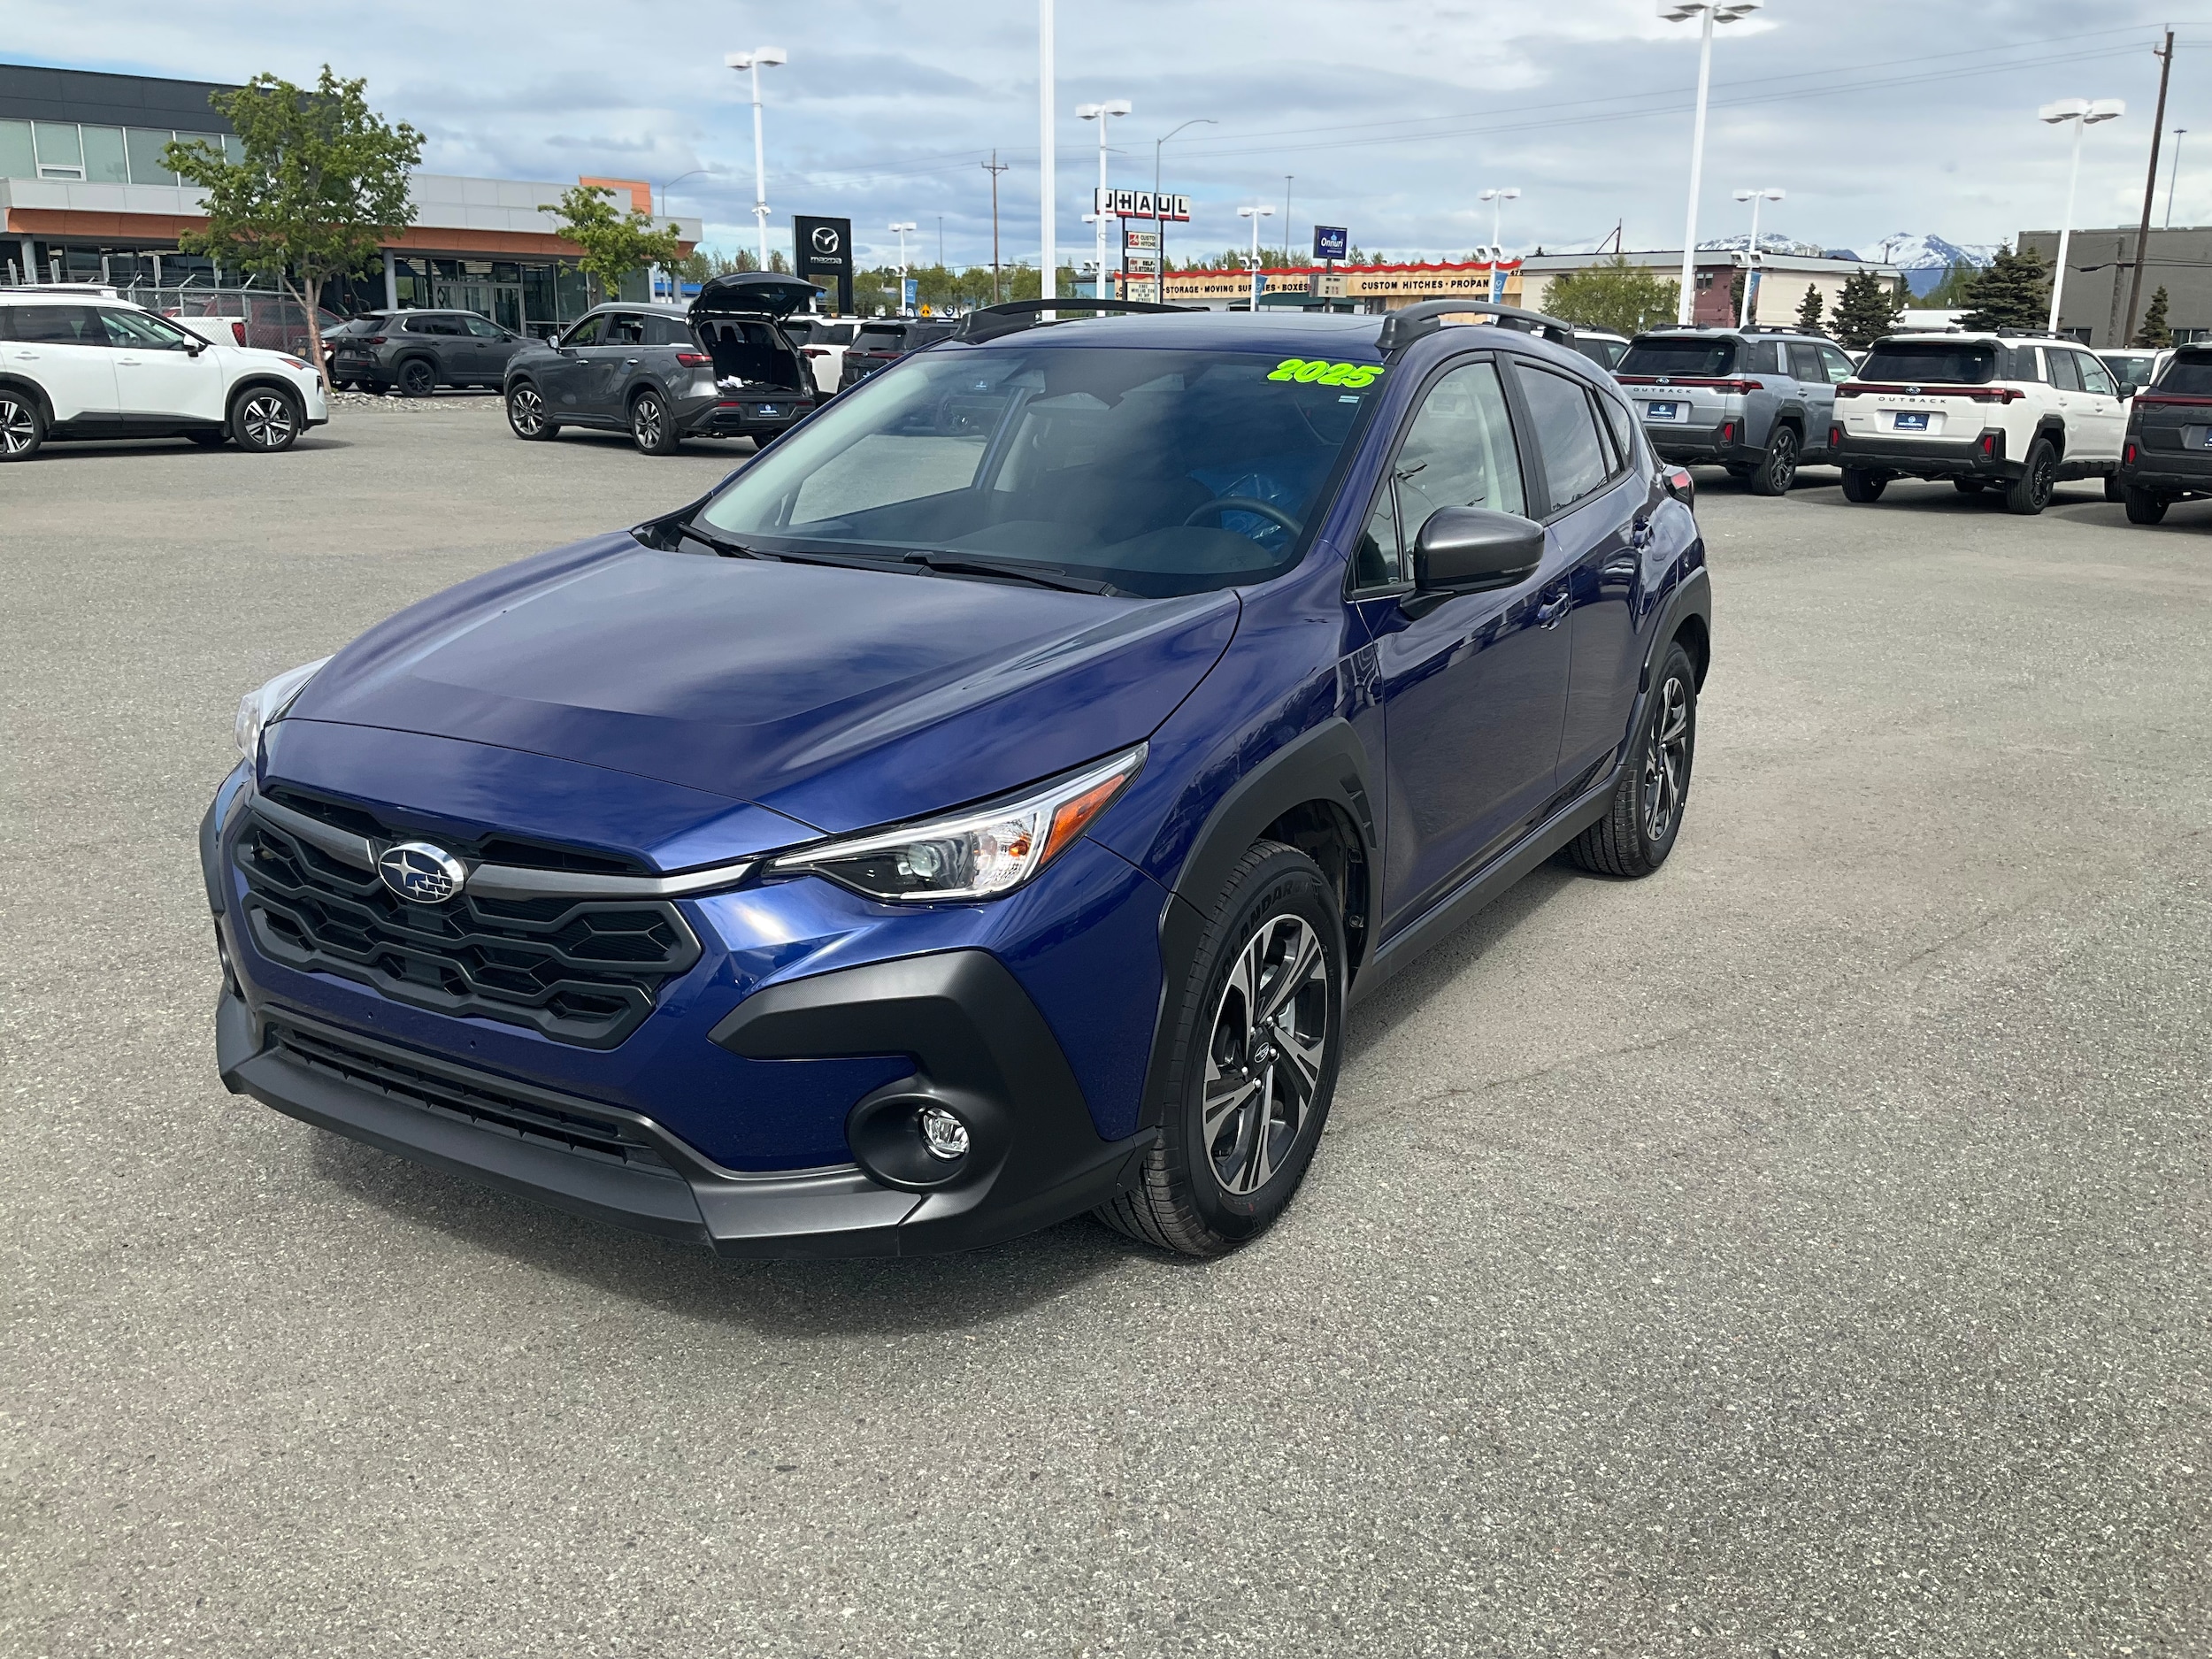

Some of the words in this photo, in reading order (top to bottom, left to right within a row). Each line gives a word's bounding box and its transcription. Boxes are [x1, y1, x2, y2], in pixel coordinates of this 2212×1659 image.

[1321, 237, 1343, 248] Onnuri
[1450, 279, 1488, 288] PROPAN
[1267, 358, 1385, 388] 2025
